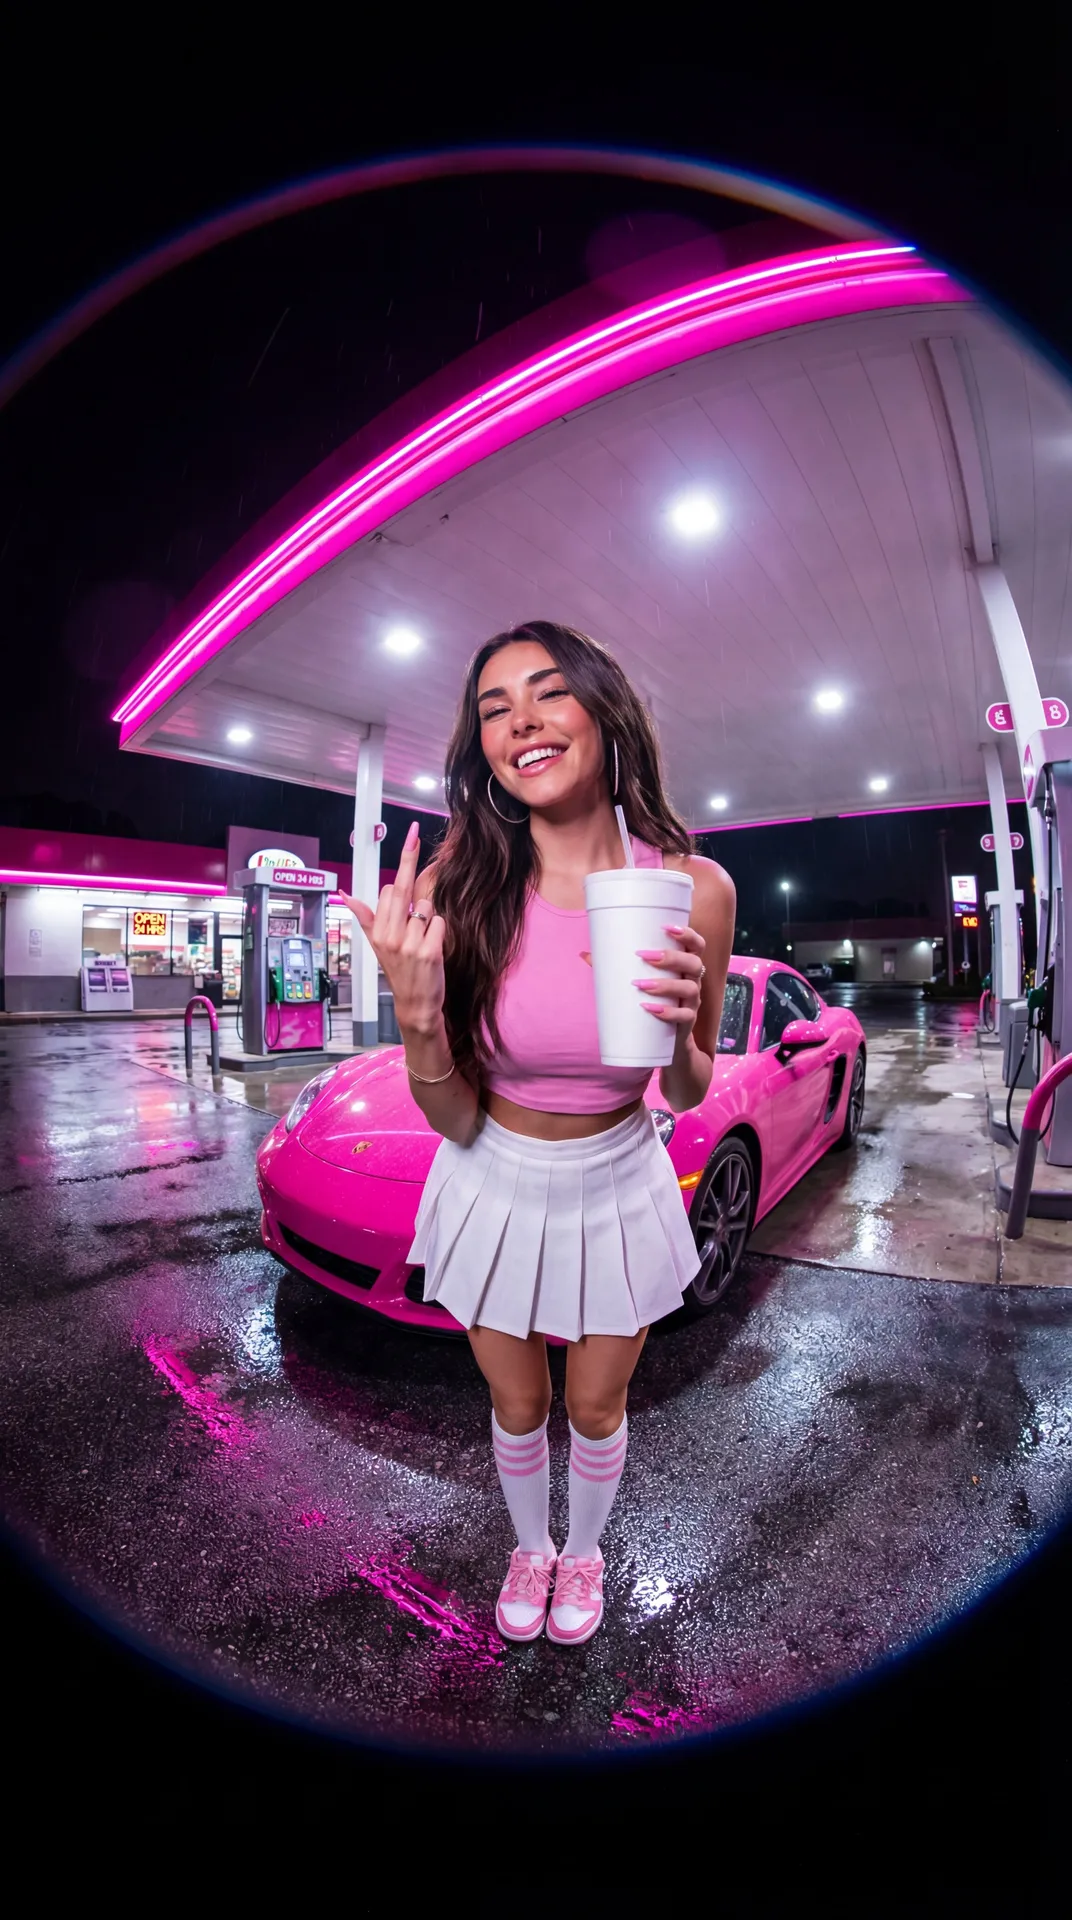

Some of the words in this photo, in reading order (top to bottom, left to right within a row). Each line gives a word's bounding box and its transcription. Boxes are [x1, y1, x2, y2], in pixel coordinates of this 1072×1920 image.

[274, 872, 296, 882] OPEN
[134, 912, 165, 925] OPEN
[146, 925, 165, 936] HRS
